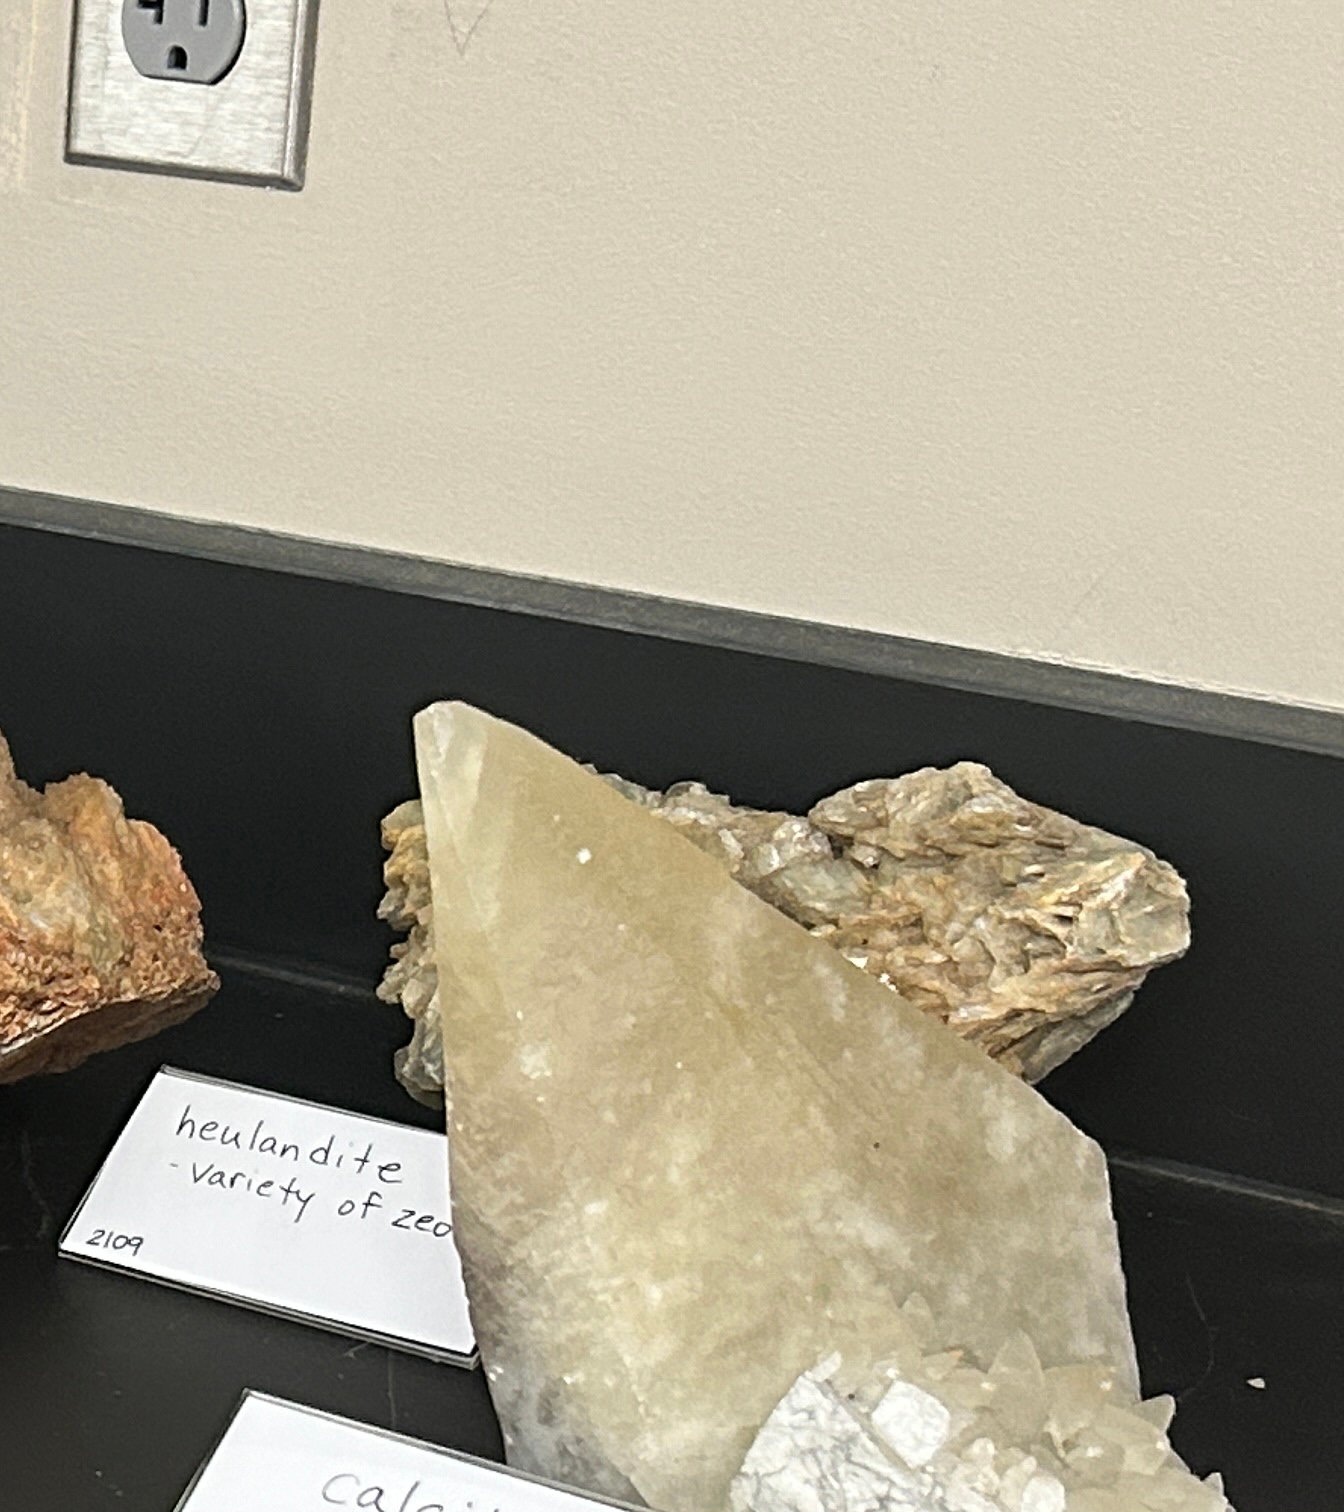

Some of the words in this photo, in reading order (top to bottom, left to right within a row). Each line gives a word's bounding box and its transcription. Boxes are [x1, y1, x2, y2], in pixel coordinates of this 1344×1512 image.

[175, 1105, 403, 1184] heulandite
[338, 1192, 383, 1218] of
[86, 1228, 144, 1256] 2109
